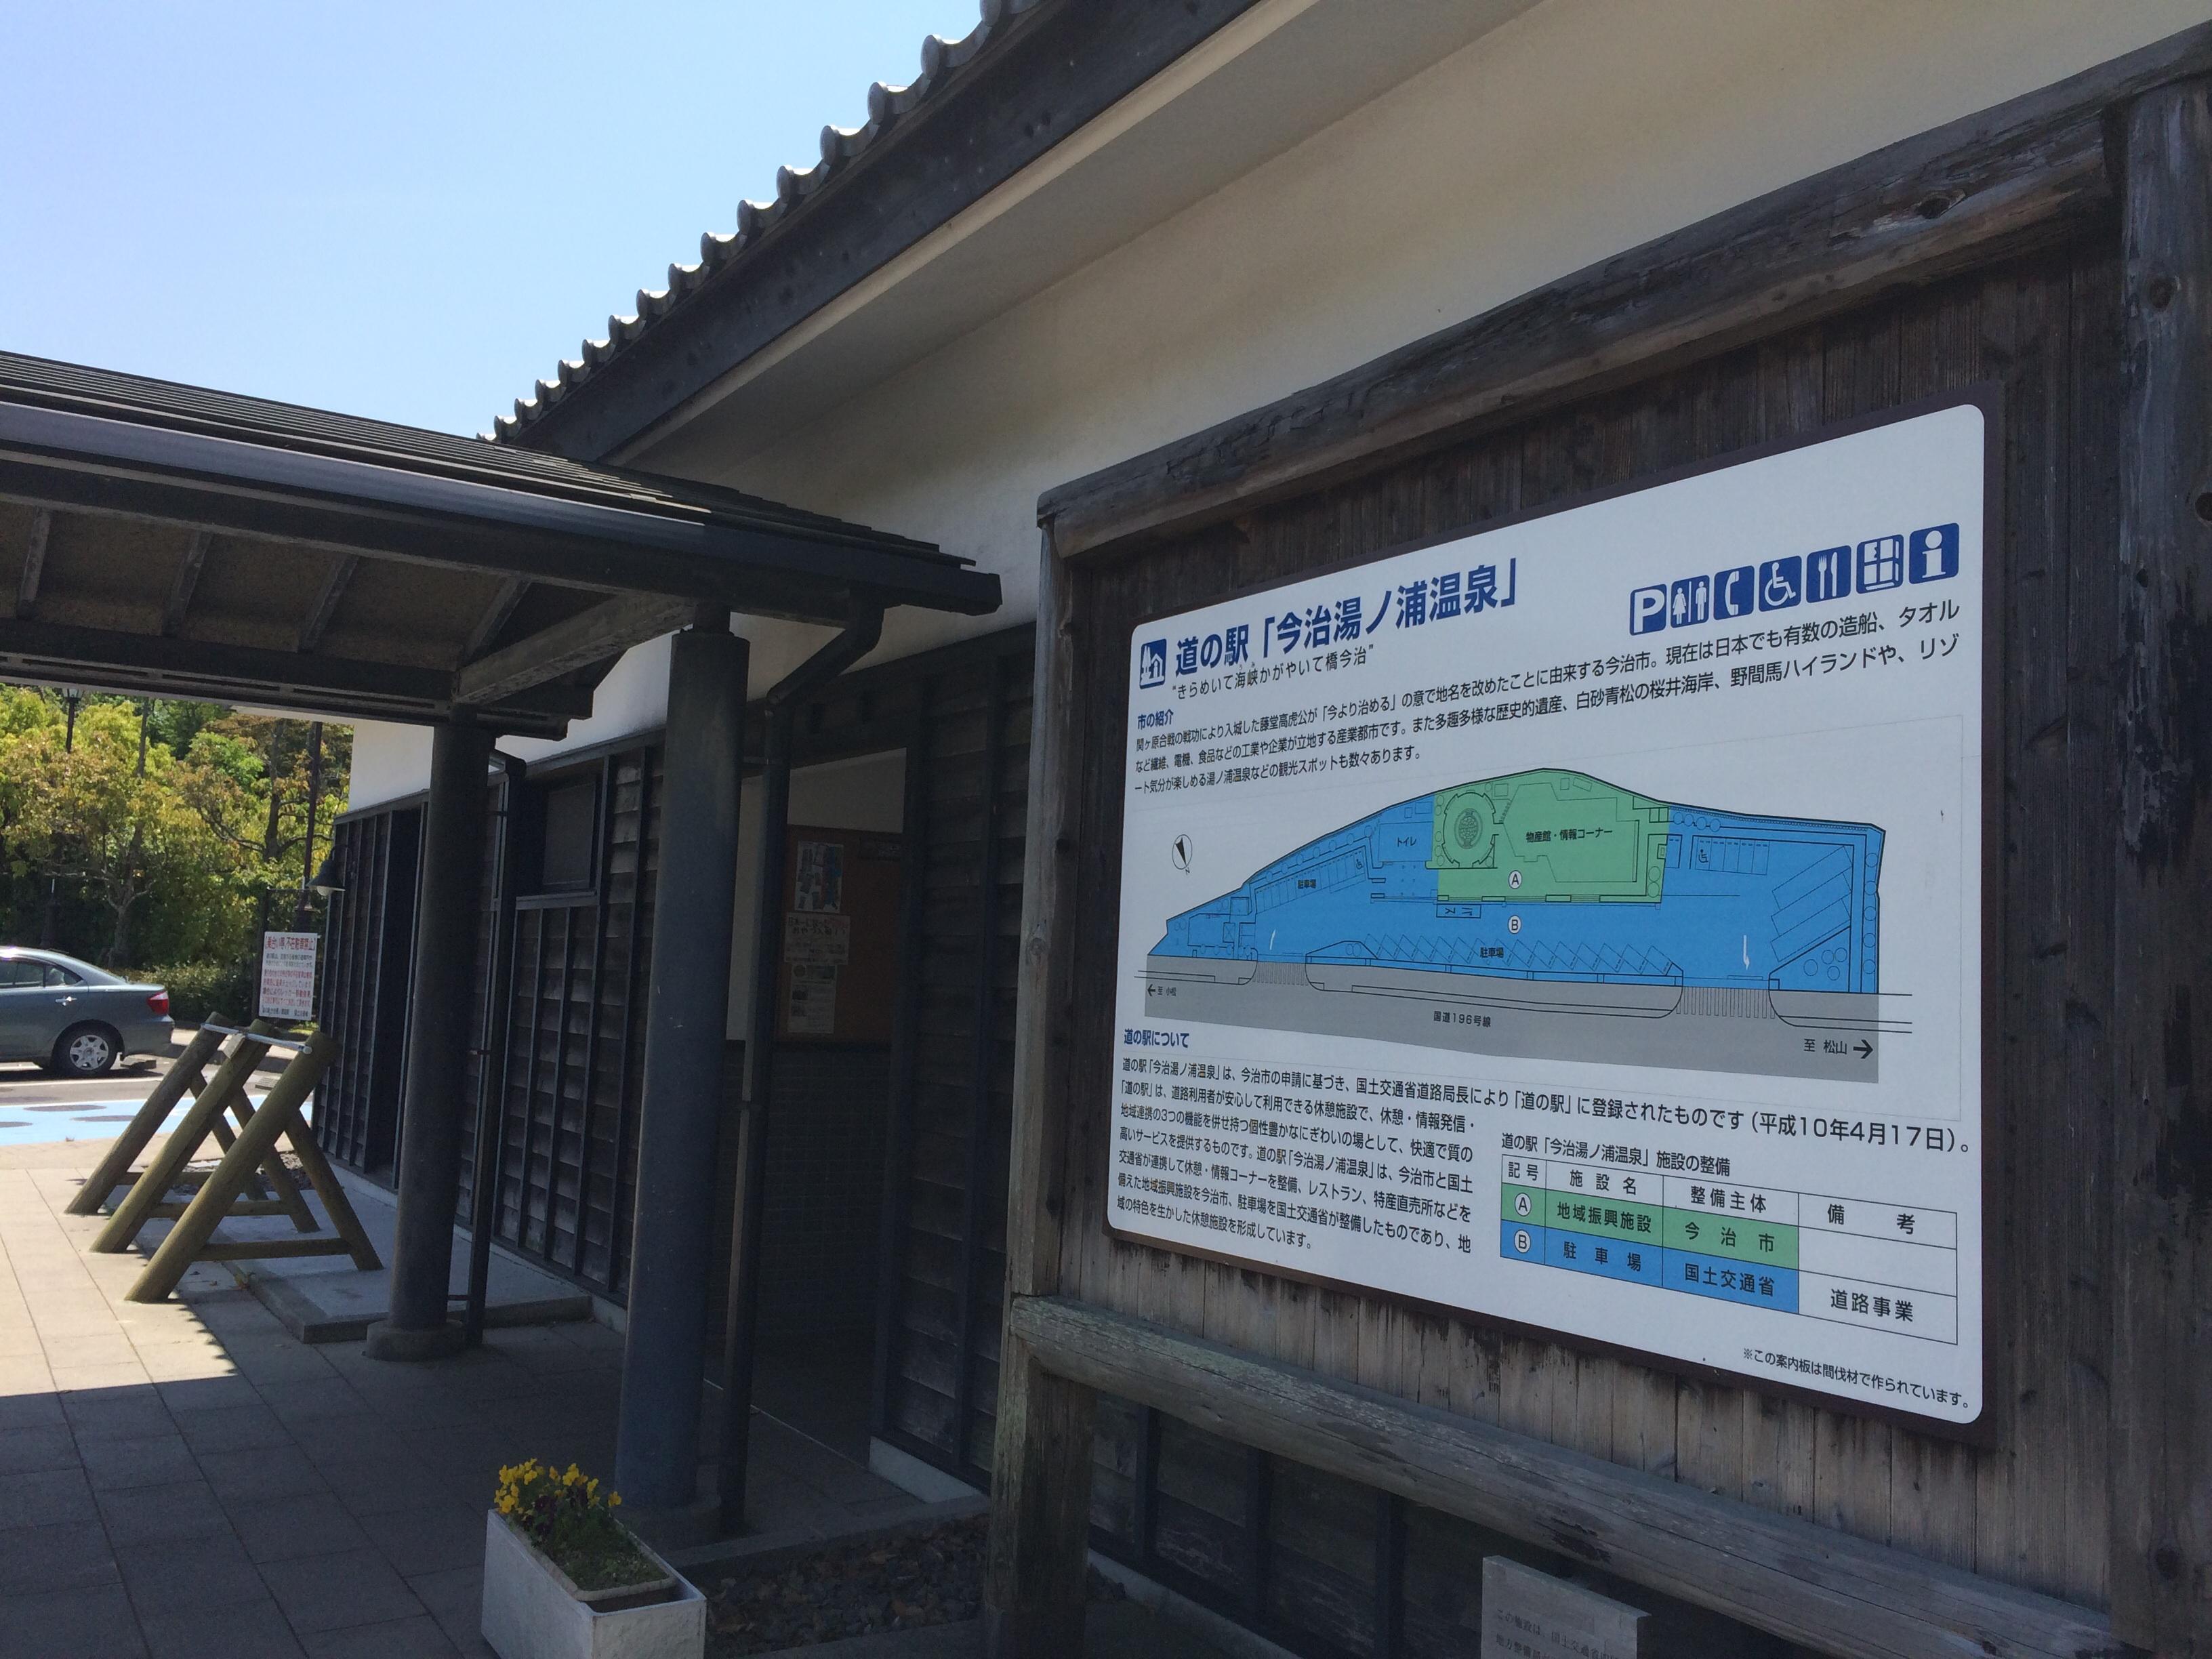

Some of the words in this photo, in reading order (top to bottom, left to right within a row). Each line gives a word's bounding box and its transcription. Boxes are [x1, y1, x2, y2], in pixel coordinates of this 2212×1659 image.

[1175, 558, 1516, 677] 道の駅「今治湯ノ浦温泉」
[1634, 588, 1665, 633] P
[1137, 709, 1174, 730] 市の紹介
[1396, 836, 1418, 848] トイレ
[1525, 827, 1613, 843] 物産館・情報コーナー
[1479, 946, 1504, 960] 駐車場
[1433, 1011, 1492, 1029] 国道196号線
[1124, 1029, 1189, 1049] 道の駅について
[1803, 1039, 1816, 1053] 至
[1823, 1040, 1847, 1055] 松山
[1501, 1132, 1731, 1177] 道の駅「今治湯ノ浦温泉」施設の整備
[1569, 1169, 1638, 1197] 施設名
[1691, 1185, 1767, 1213] 整備主体
[1557, 1201, 1652, 1235] 地域振興施設
[1685, 1222, 1775, 1253] 今治市
[1563, 1241, 1641, 1273] 駐車場
[1685, 1263, 1775, 1297] 国土交通省
[1831, 1289, 1914, 1323] 道路事業
